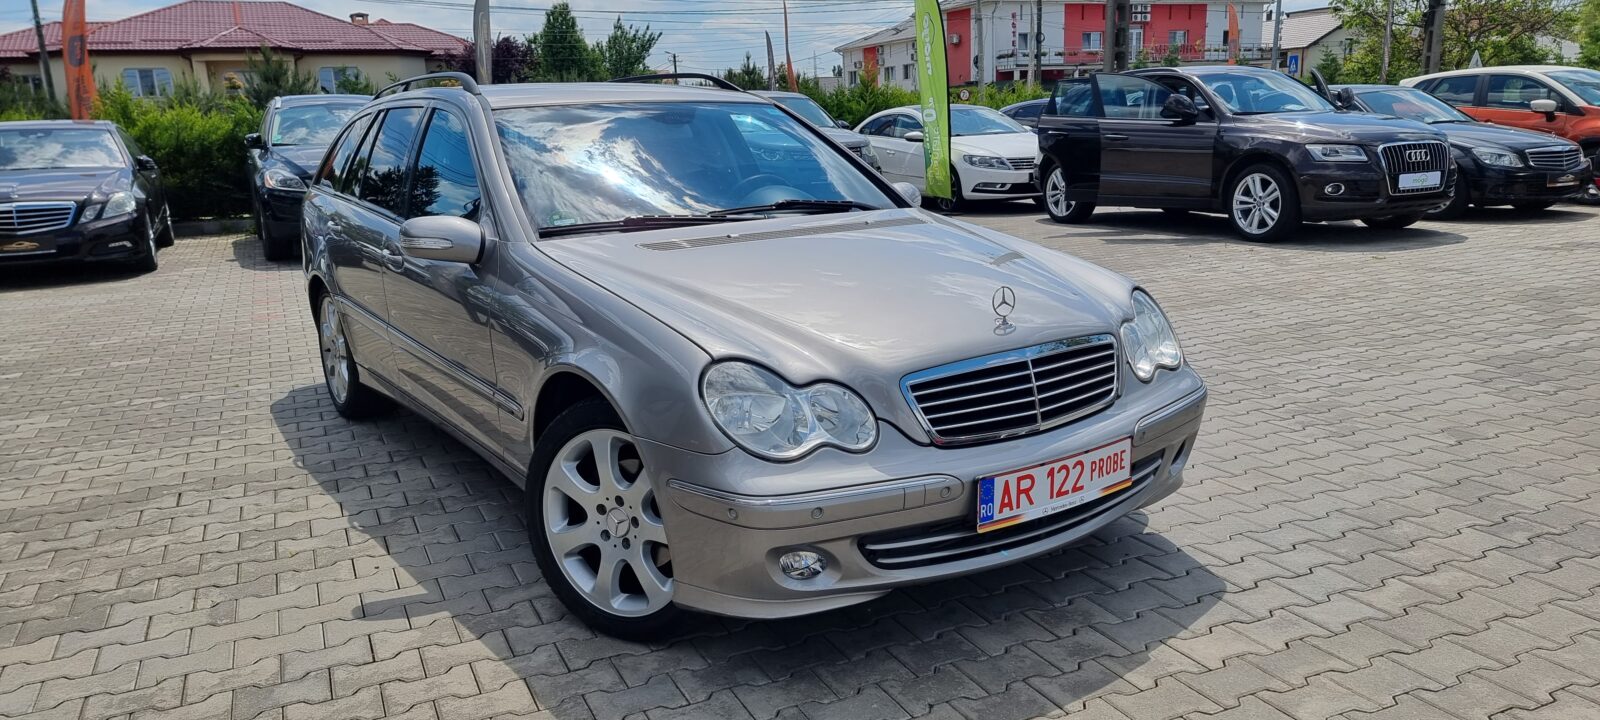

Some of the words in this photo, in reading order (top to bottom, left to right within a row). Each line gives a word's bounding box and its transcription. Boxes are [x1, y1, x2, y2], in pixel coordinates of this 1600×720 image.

[998, 473, 1036, 514] AR
[1046, 459, 1085, 500] 122
[1090, 449, 1126, 482] PROBE
[980, 502, 993, 518] RO
